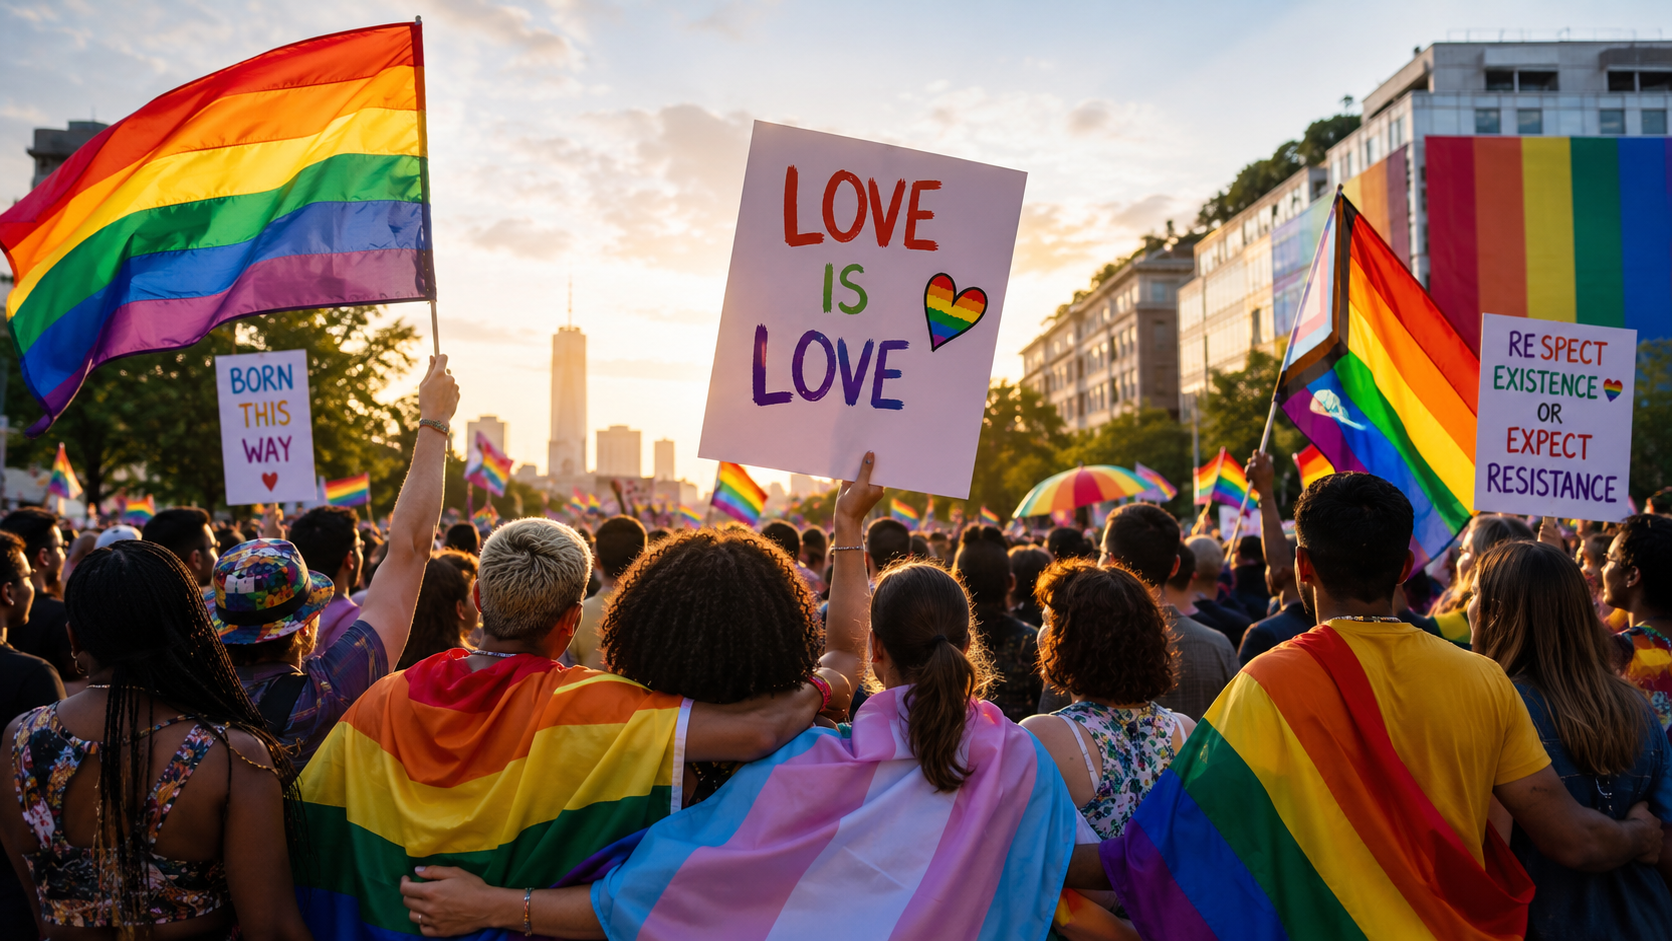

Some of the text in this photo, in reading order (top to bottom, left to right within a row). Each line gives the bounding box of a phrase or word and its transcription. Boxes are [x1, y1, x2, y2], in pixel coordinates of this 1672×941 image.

[783, 165, 943, 251] LOVE
[822, 262, 868, 315] IS
[1508, 330, 1609, 366] RE SPECT
[229, 363, 293, 394] BORN
[752, 323, 910, 410] LOVE
[1493, 365, 1598, 400] EXISTENCE
[238, 400, 291, 428] THIS
[1537, 402, 1563, 424] OR
[242, 435, 292, 463] WAY
[1506, 426, 1593, 460] EXPECT
[1487, 462, 1618, 503] RESISTANCE
